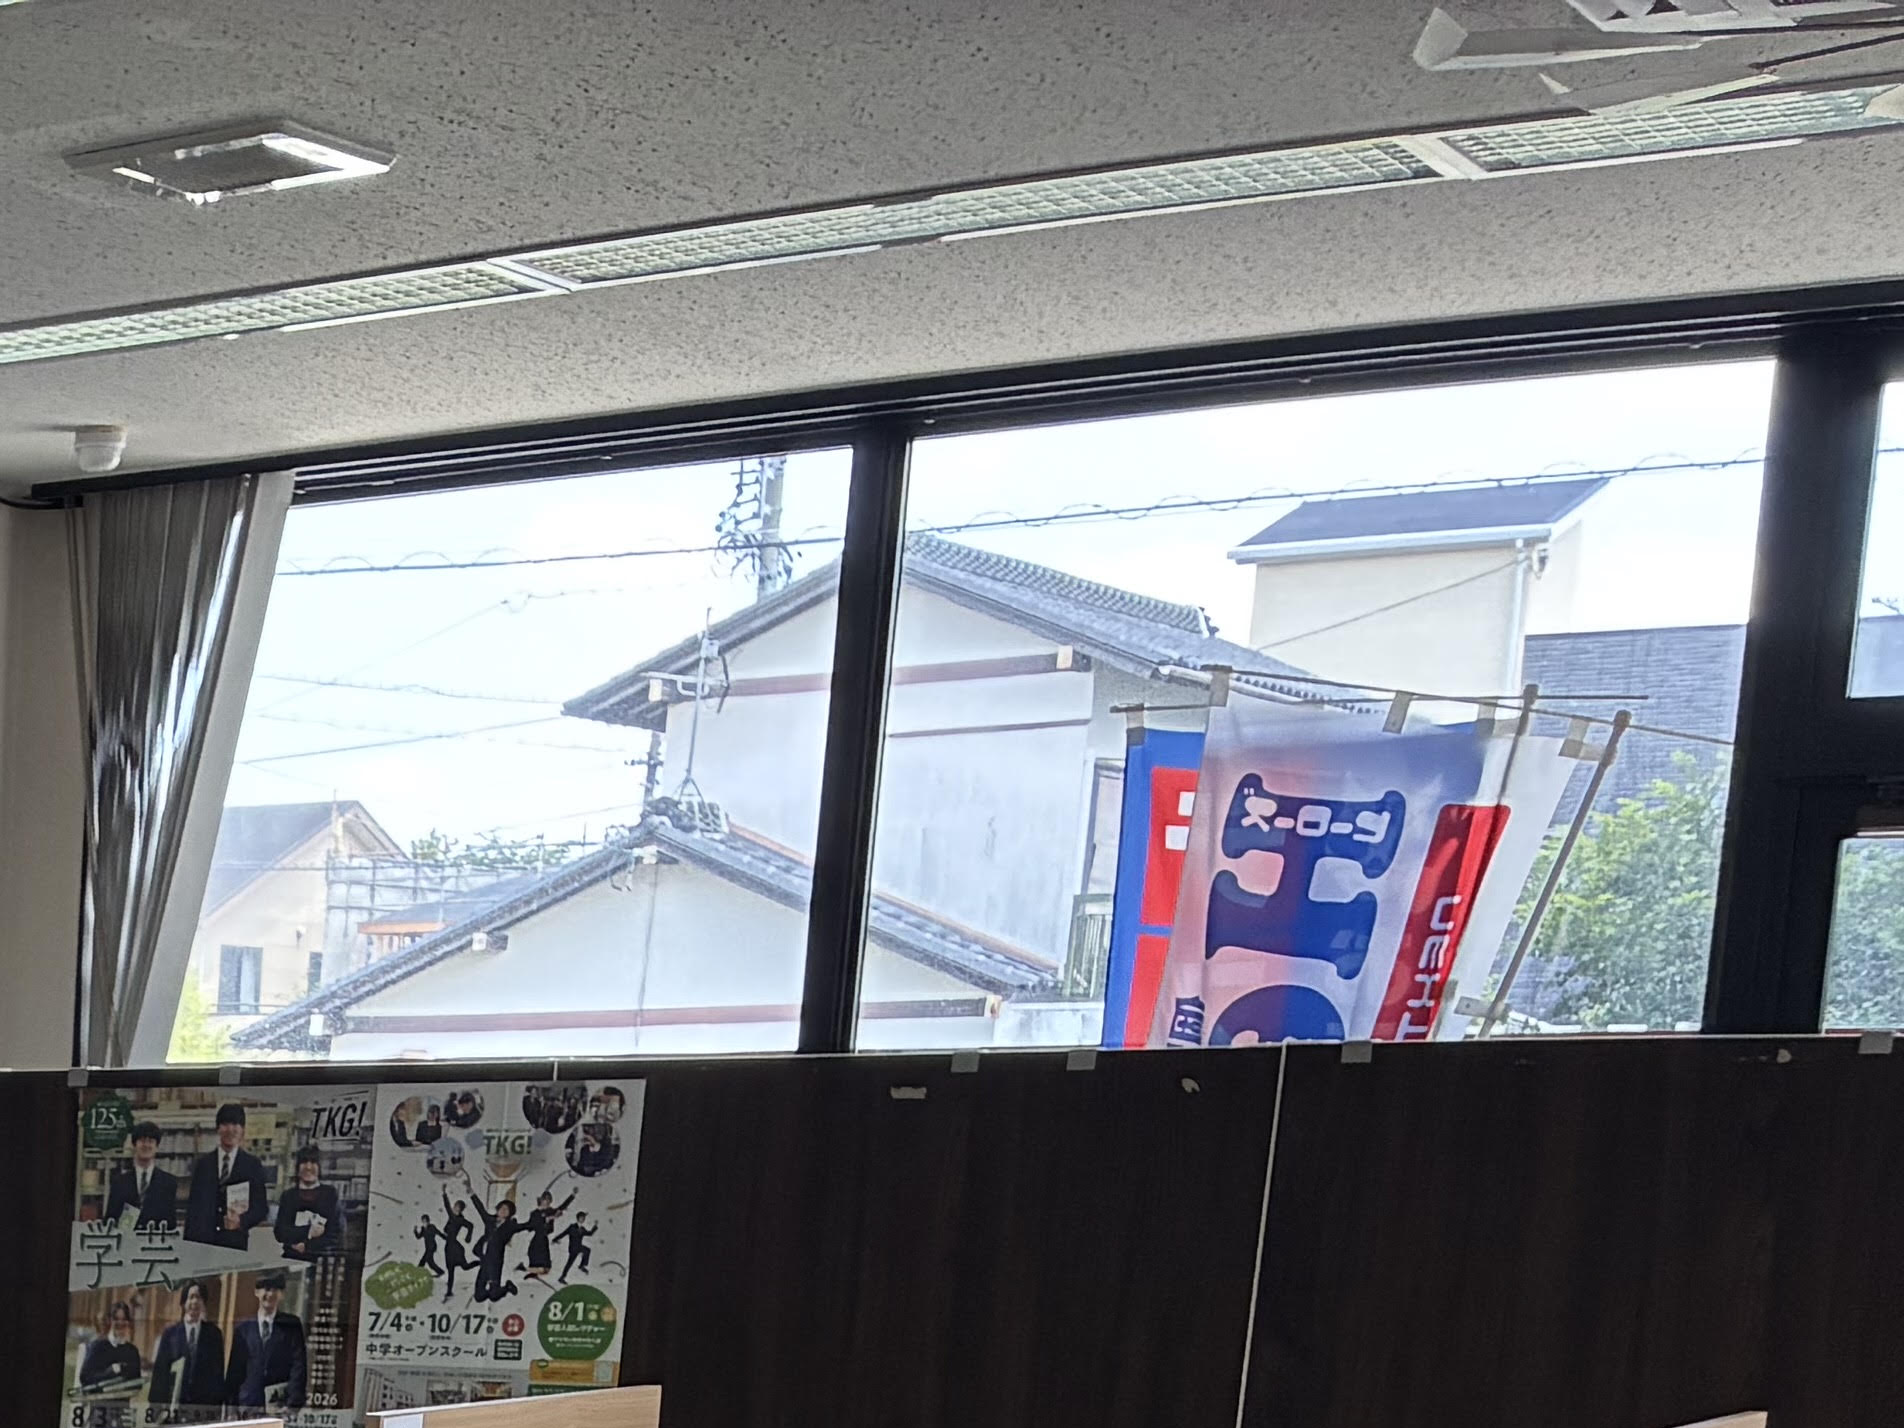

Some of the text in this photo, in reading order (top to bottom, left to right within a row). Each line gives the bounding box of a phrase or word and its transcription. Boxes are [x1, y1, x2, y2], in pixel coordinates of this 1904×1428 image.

[310, 1101, 369, 1139] TKG!
[483, 1134, 533, 1156] TKG!
[75, 1217, 181, 1292] 学芸
[365, 1343, 488, 1358] 中学オープンスクール
[306, 1391, 339, 1406] 2026
